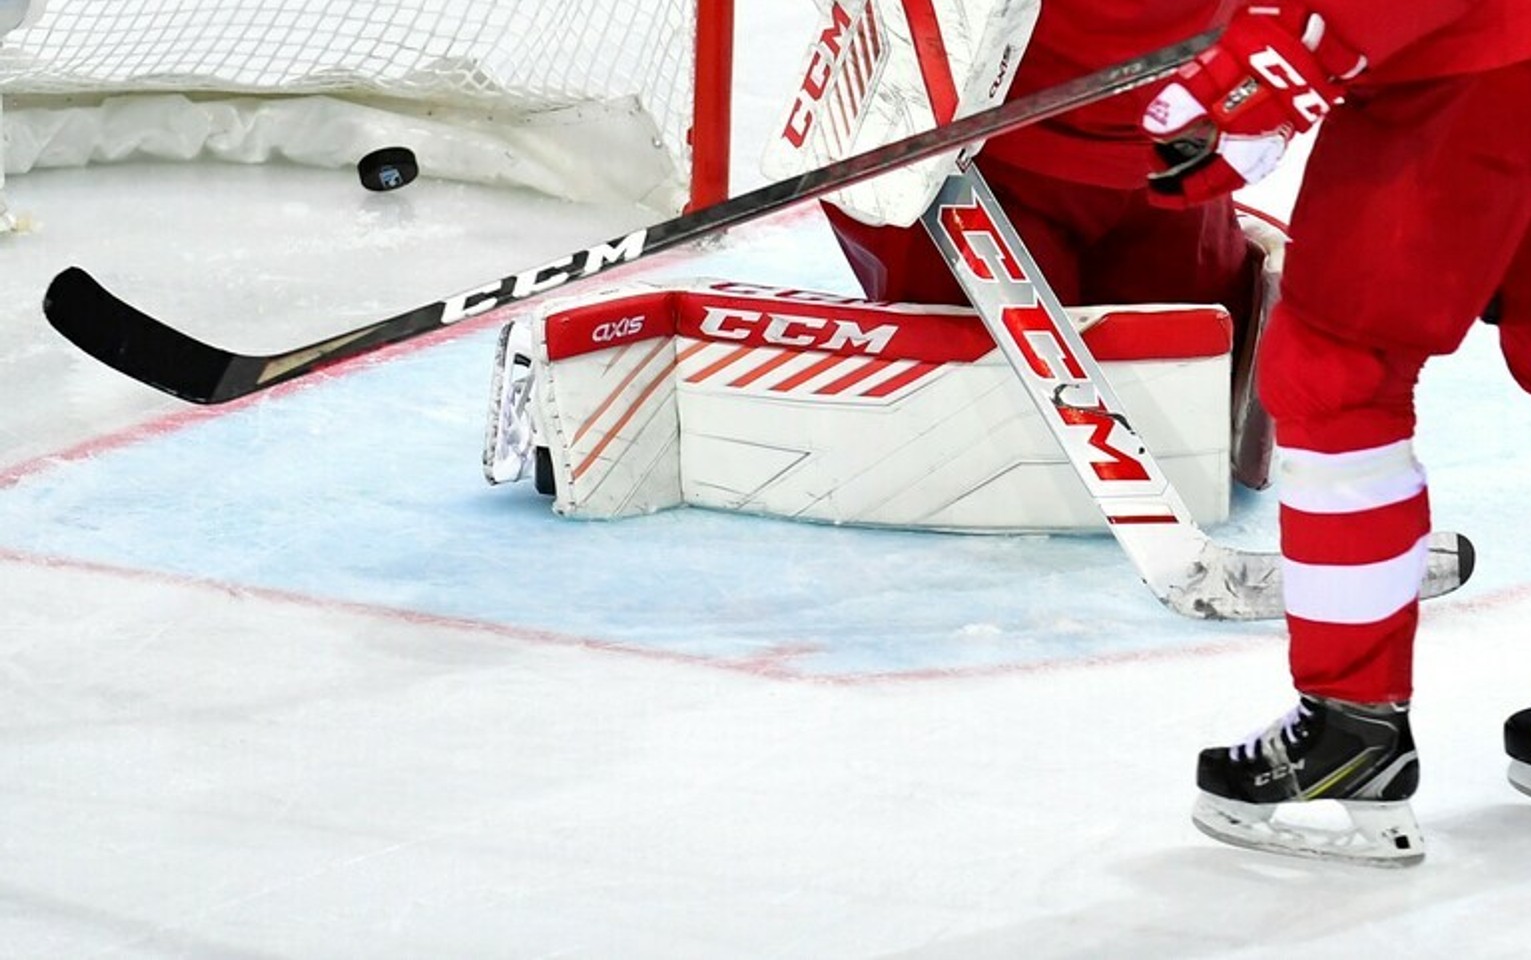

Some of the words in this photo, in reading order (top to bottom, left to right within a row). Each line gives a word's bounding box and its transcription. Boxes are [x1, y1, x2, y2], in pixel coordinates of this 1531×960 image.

[782, 0, 851, 148] CCM
[1249, 45, 1331, 123] CC
[440, 229, 649, 325] CCM
[700, 306, 899, 354] CCM
[936, 188, 1151, 481] CCM
